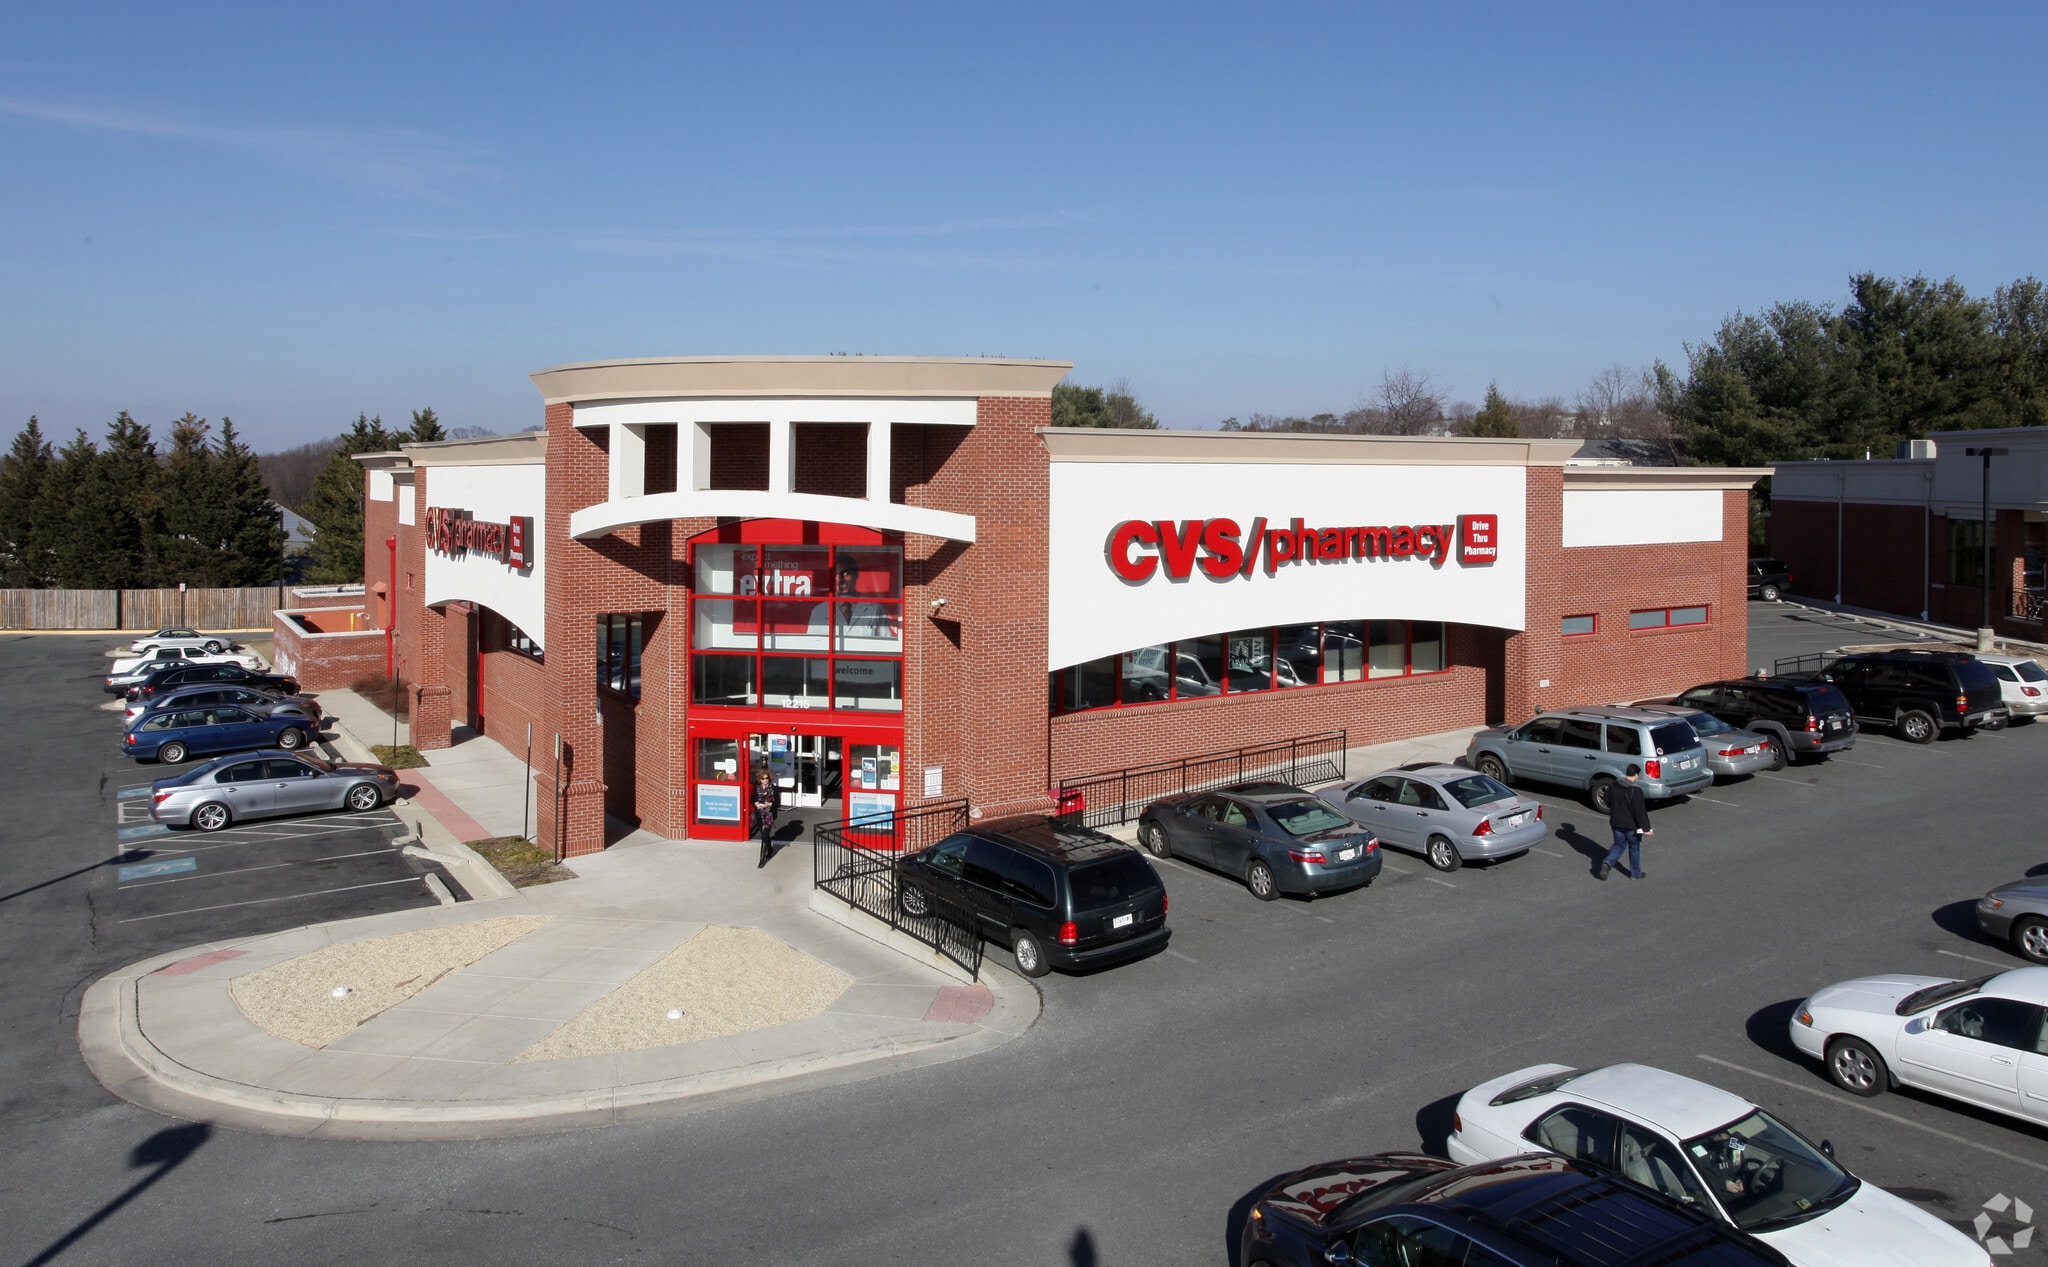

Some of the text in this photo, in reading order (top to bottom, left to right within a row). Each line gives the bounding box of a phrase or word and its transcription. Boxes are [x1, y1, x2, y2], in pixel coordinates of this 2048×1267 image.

[1472, 520, 1489, 531] Drive
[1472, 533, 1489, 543] Thru
[1109, 516, 1456, 582] CVS/pharmacy
[1464, 545, 1497, 556] Pharmacy
[741, 552, 771, 561] expt
[753, 560, 799, 571] smething
[835, 665, 874, 676] welcome
[782, 698, 810, 709] 12215
